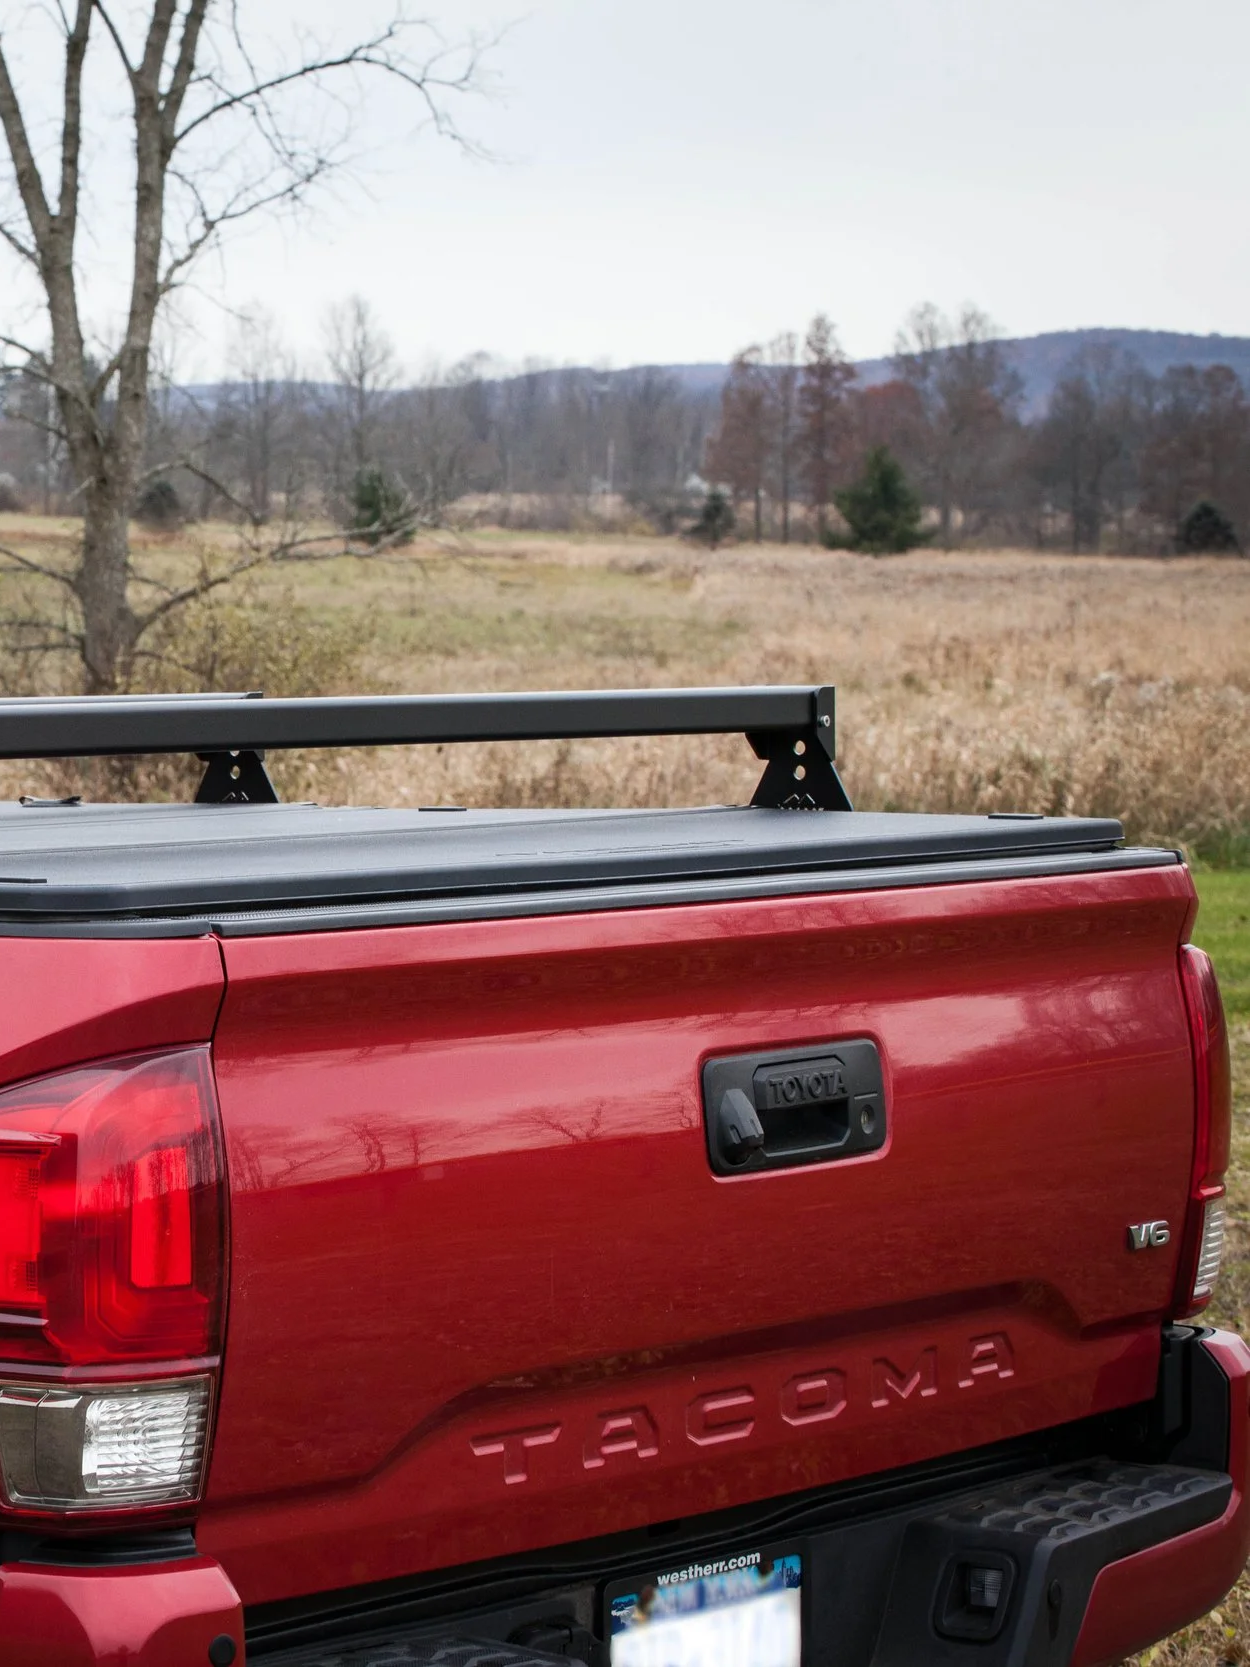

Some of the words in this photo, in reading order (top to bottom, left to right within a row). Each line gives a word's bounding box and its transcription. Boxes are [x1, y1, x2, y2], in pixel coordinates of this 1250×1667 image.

[768, 1068, 848, 1104] TOYOTA
[1127, 1220, 1170, 1250] V6
[468, 1330, 1016, 1485] TACOMA
[656, 1551, 761, 1586] westherr.com
